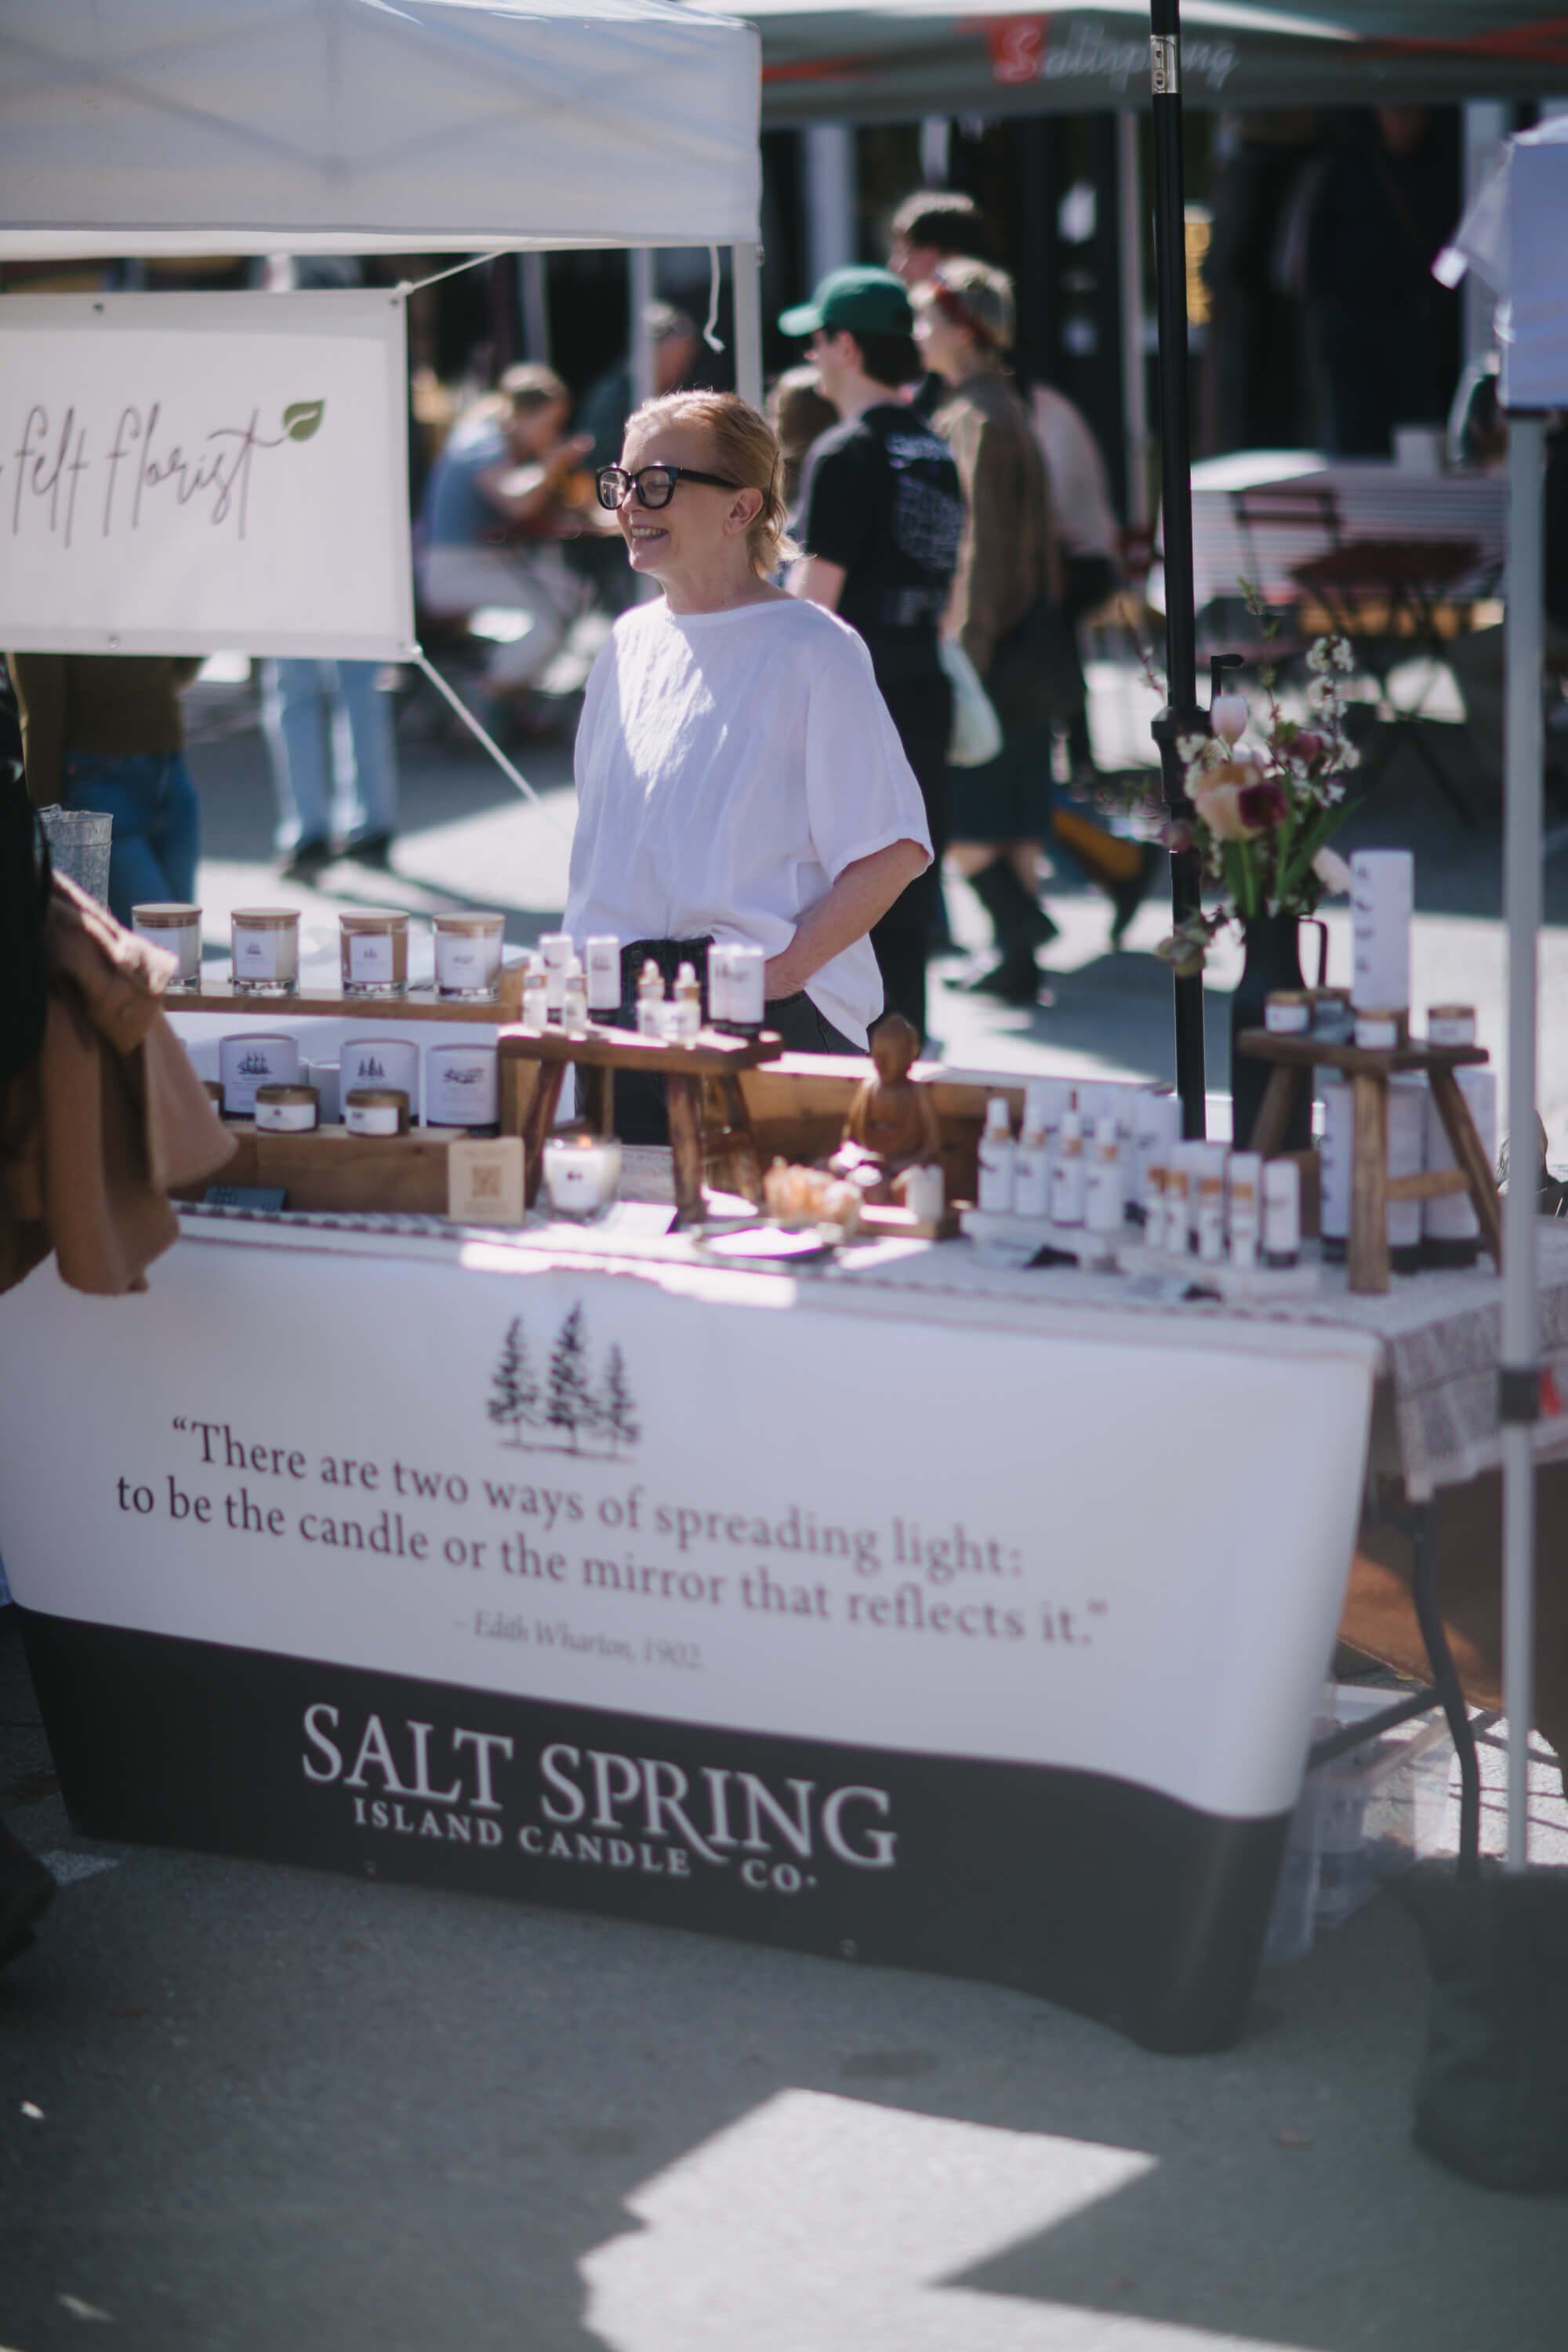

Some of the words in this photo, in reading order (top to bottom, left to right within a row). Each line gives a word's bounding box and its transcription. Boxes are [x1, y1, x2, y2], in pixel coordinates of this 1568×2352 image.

[0, 403, 89, 549] felt
[103, 400, 285, 541] florist
[117, 1476, 154, 1514] to
[167, 1475, 212, 1523] be
[225, 1487, 285, 1537] the
[299, 1511, 430, 1561] candle
[444, 1535, 487, 1570] or
[500, 1532, 567, 1582] the
[583, 1552, 726, 1606] mirror
[740, 1565, 831, 1621] that
[847, 1581, 1025, 1639] reflects
[320, 1455, 378, 1490] are
[393, 1460, 469, 1504] two
[483, 1479, 584, 1533] ways
[598, 1485, 644, 1530] of
[656, 1504, 880, 1577] spreading
[891, 1516, 1022, 1586] light:
[474, 1609, 530, 1643] Edith
[644, 1636, 705, 1671] 1902
[301, 1701, 514, 1812] SALT
[539, 1741, 899, 1870] SPRING
[353, 1796, 504, 1848] ISLAND
[518, 1824, 691, 1877] CANDLE
